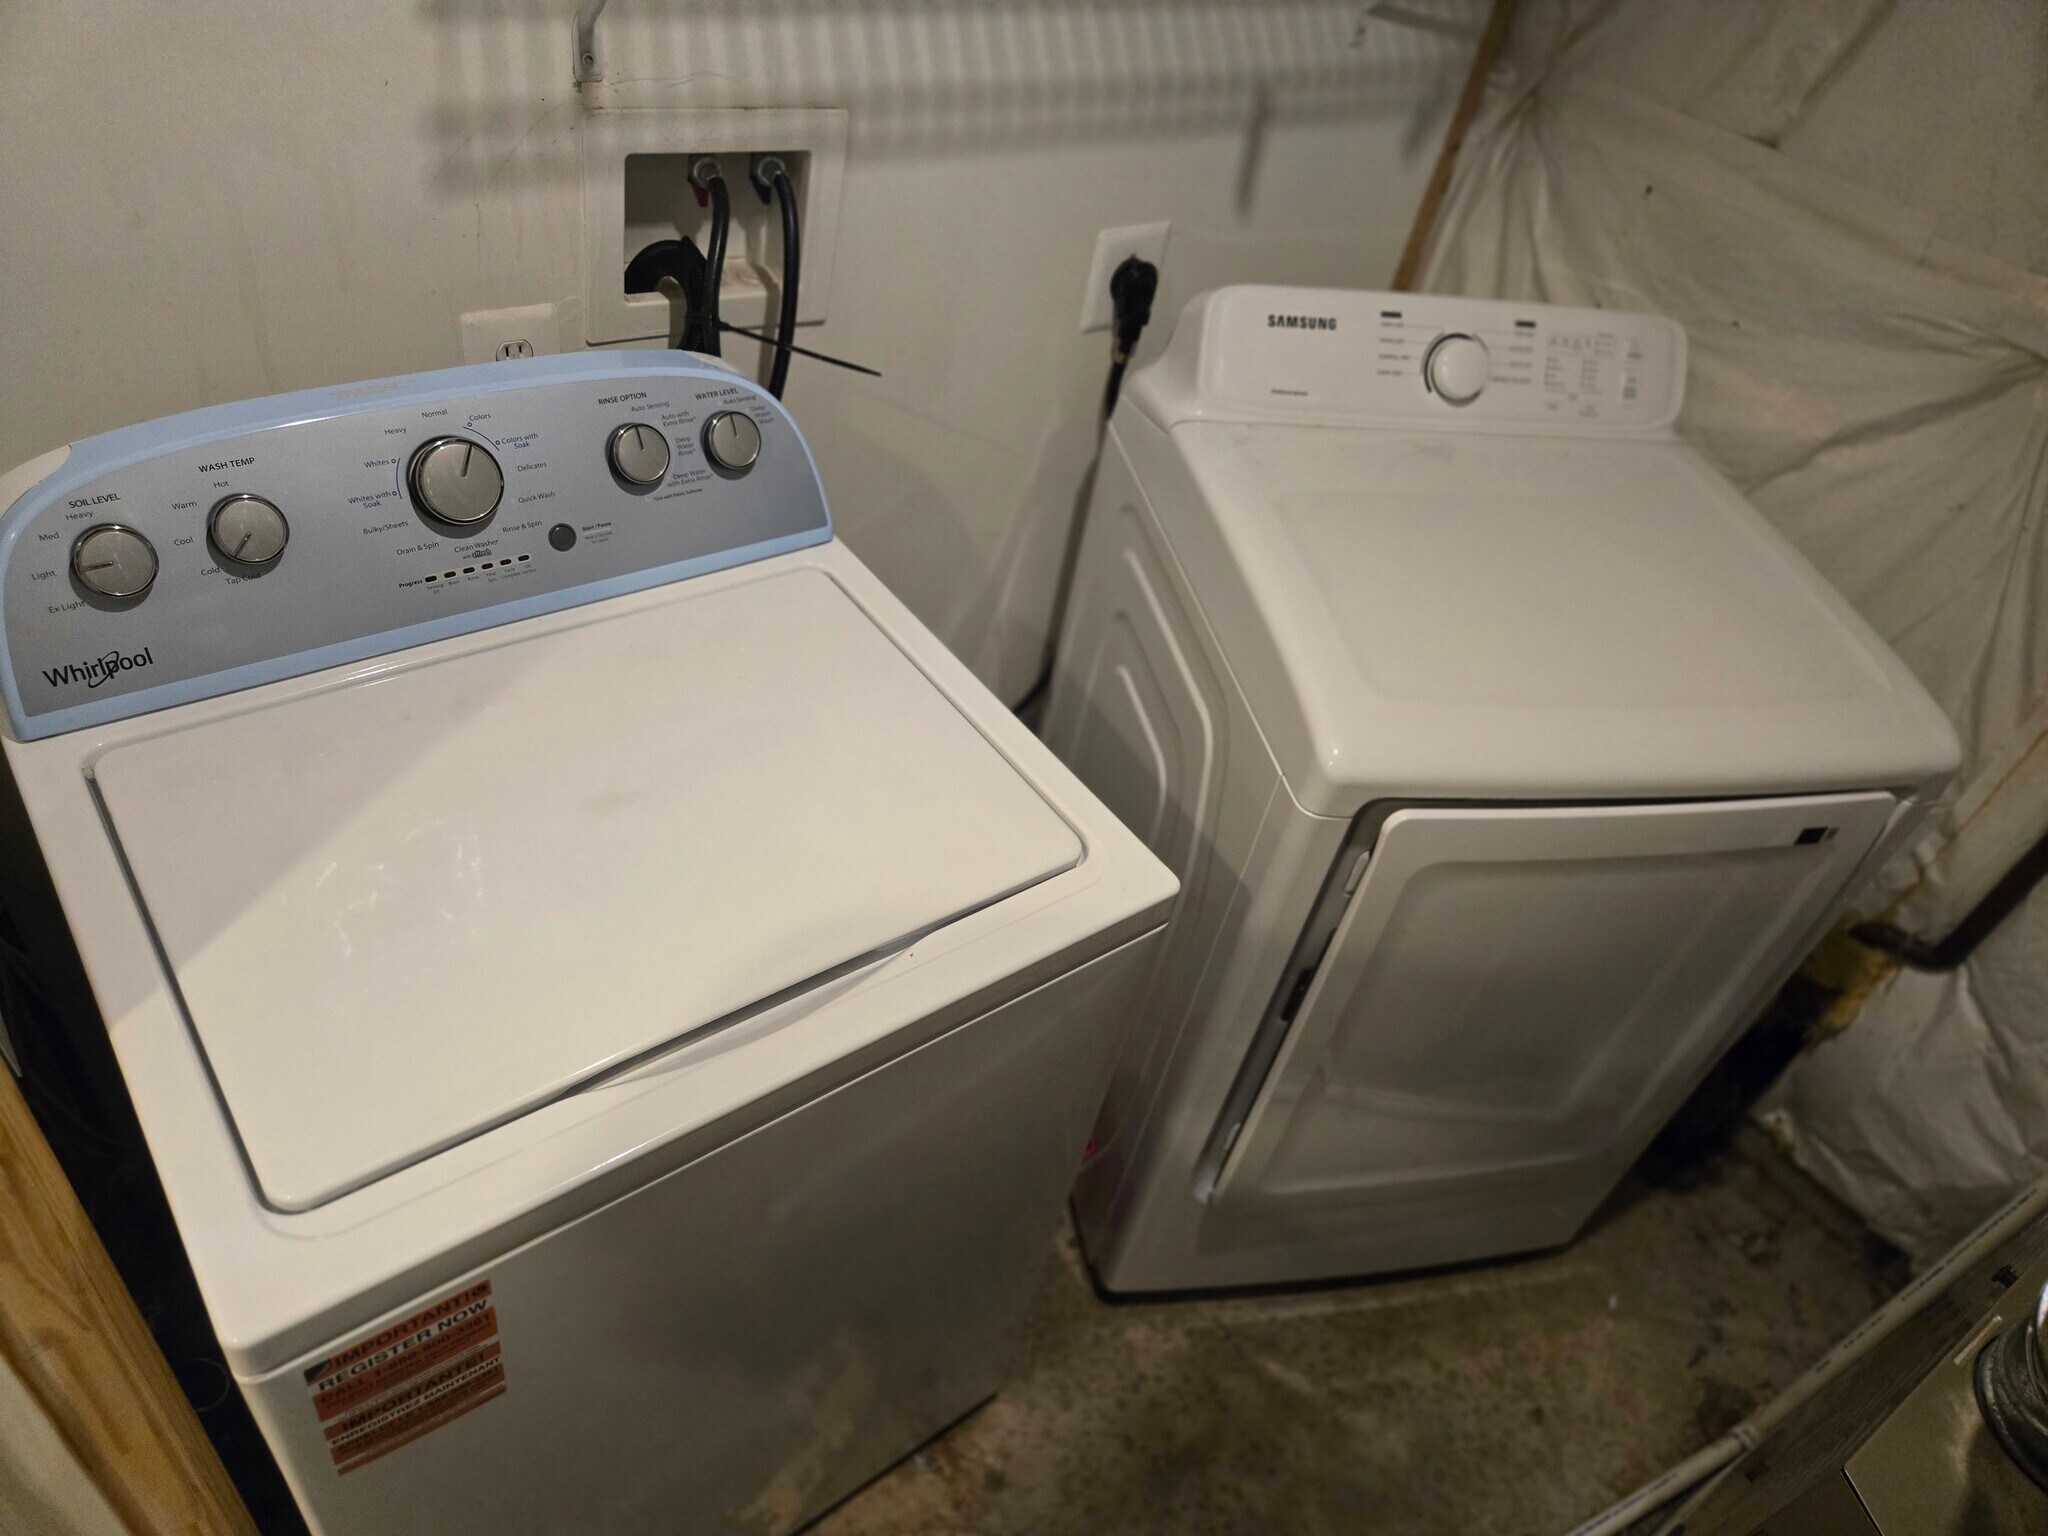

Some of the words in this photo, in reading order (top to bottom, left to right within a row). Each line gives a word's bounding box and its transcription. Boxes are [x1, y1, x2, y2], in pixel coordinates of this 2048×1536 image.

[1268, 314, 1337, 331] SAMSUNG
[598, 396, 619, 405] RINSE
[620, 392, 647, 402] OPTION
[695, 391, 719, 400] WATER
[720, 388, 738, 396] LEVEL
[647, 401, 670, 410] Sensing
[421, 408, 448, 418] Normal
[469, 414, 491, 422] Colors
[677, 410, 690, 418] with
[384, 427, 407, 436] Heavy
[501, 435, 522, 445] Colors
[524, 432, 539, 440] with
[514, 441, 530, 449] Soak
[198, 462, 228, 473] WASH
[229, 457, 255, 468] TEMP
[364, 459, 390, 469] Whites
[517, 462, 547, 472] Delicates
[213, 480, 230, 488] Hot
[69, 499, 91, 509] SOIL
[92, 493, 121, 504] LEVEL
[348, 494, 374, 504] Whites
[375, 491, 391, 499] with
[518, 495, 537, 504] Quick
[538, 491, 556, 500] Wash
[172, 500, 197, 510] Warm
[363, 501, 381, 509] Soak
[65, 510, 94, 520] Heavy
[363, 520, 409, 535] Bulky/Sheets
[502, 524, 520, 533] Rinse
[527, 520, 543, 529] Spin
[39, 532, 60, 541] Med
[173, 536, 194, 546] Cool
[396, 546, 416, 556] Drain
[424, 542, 440, 552] Spin
[454, 544, 474, 553] Clean
[474, 540, 499, 549] Washer
[31, 570, 56, 581] Light
[201, 567, 221, 576] Cold
[226, 577, 241, 585] Tap
[242, 573, 261, 582] Cold
[399, 580, 423, 588] Progress
[62, 601, 85, 612] Light
[42, 647, 153, 688] Whirlpool
[319, 1329, 431, 1391] REGISTER
[438, 1299, 487, 1331] NOW
[424, 1355, 501, 1400] MAINTENANT
